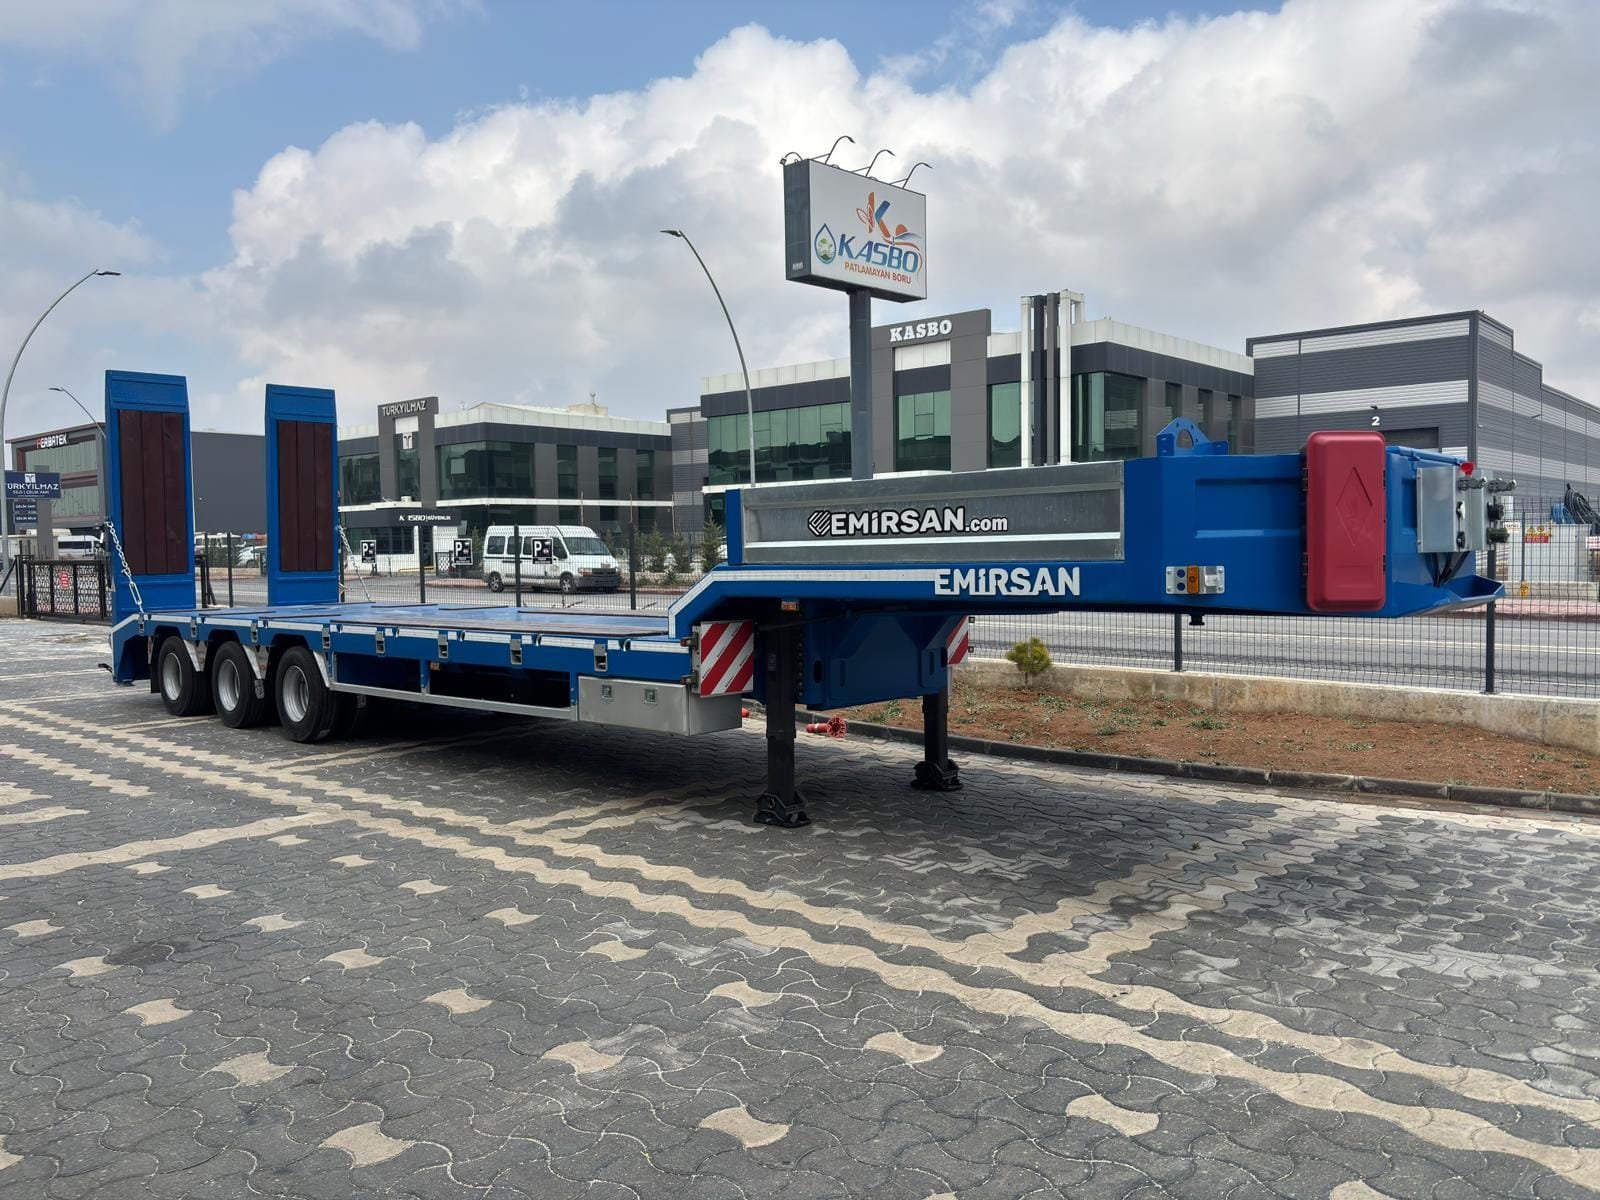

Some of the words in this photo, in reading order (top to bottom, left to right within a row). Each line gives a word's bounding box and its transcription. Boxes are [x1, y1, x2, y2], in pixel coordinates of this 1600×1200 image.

[837, 233, 919, 273] KASBO
[844, 261, 891, 279] PATLAMAYAN
[892, 272, 912, 284] BORU
[889, 319, 953, 343] KASBO
[1371, 416, 1381, 426] 2
[362, 543, 369, 556] P
[455, 541, 463, 557] P
[534, 541, 542, 557] P
